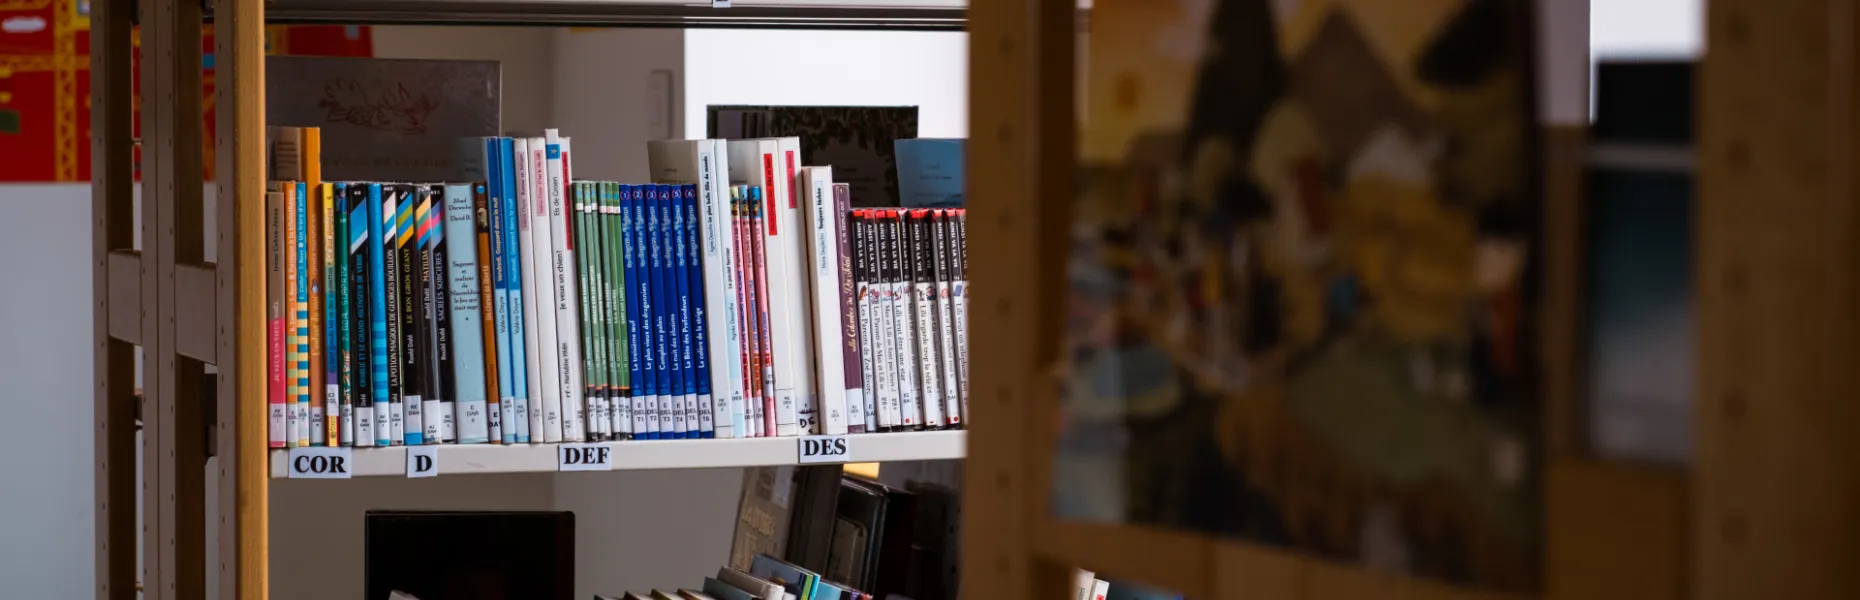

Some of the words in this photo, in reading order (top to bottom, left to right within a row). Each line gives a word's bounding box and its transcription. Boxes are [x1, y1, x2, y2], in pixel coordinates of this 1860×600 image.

[553, 198, 559, 206] de
[857, 240, 862, 248] VA
[869, 243, 874, 251] VA
[880, 241, 886, 249] VA
[939, 241, 944, 249] VA
[952, 240, 956, 248] VA
[892, 250, 897, 258] LA
[917, 252, 921, 260] LA
[435, 252, 443, 289] SORCIÈRES
[340, 264, 348, 305] SURPRISE
[559, 275, 564, 283] un
[641, 283, 649, 318] dragonniers
[406, 315, 412, 323] LE
[695, 308, 703, 324] strige
[657, 316, 666, 333] palais
[920, 320, 929, 345] regarde
[898, 337, 906, 350] être
[645, 349, 653, 361] plus
[658, 343, 666, 370] Complot
[683, 346, 691, 359] Bête
[696, 342, 704, 359] colère
[864, 347, 870, 355] de
[864, 358, 872, 371] Zoé
[391, 378, 397, 386] LA
[803, 438, 846, 456] DES
[563, 447, 610, 464] DEF
[294, 455, 346, 473] COR
[414, 454, 432, 472] D
